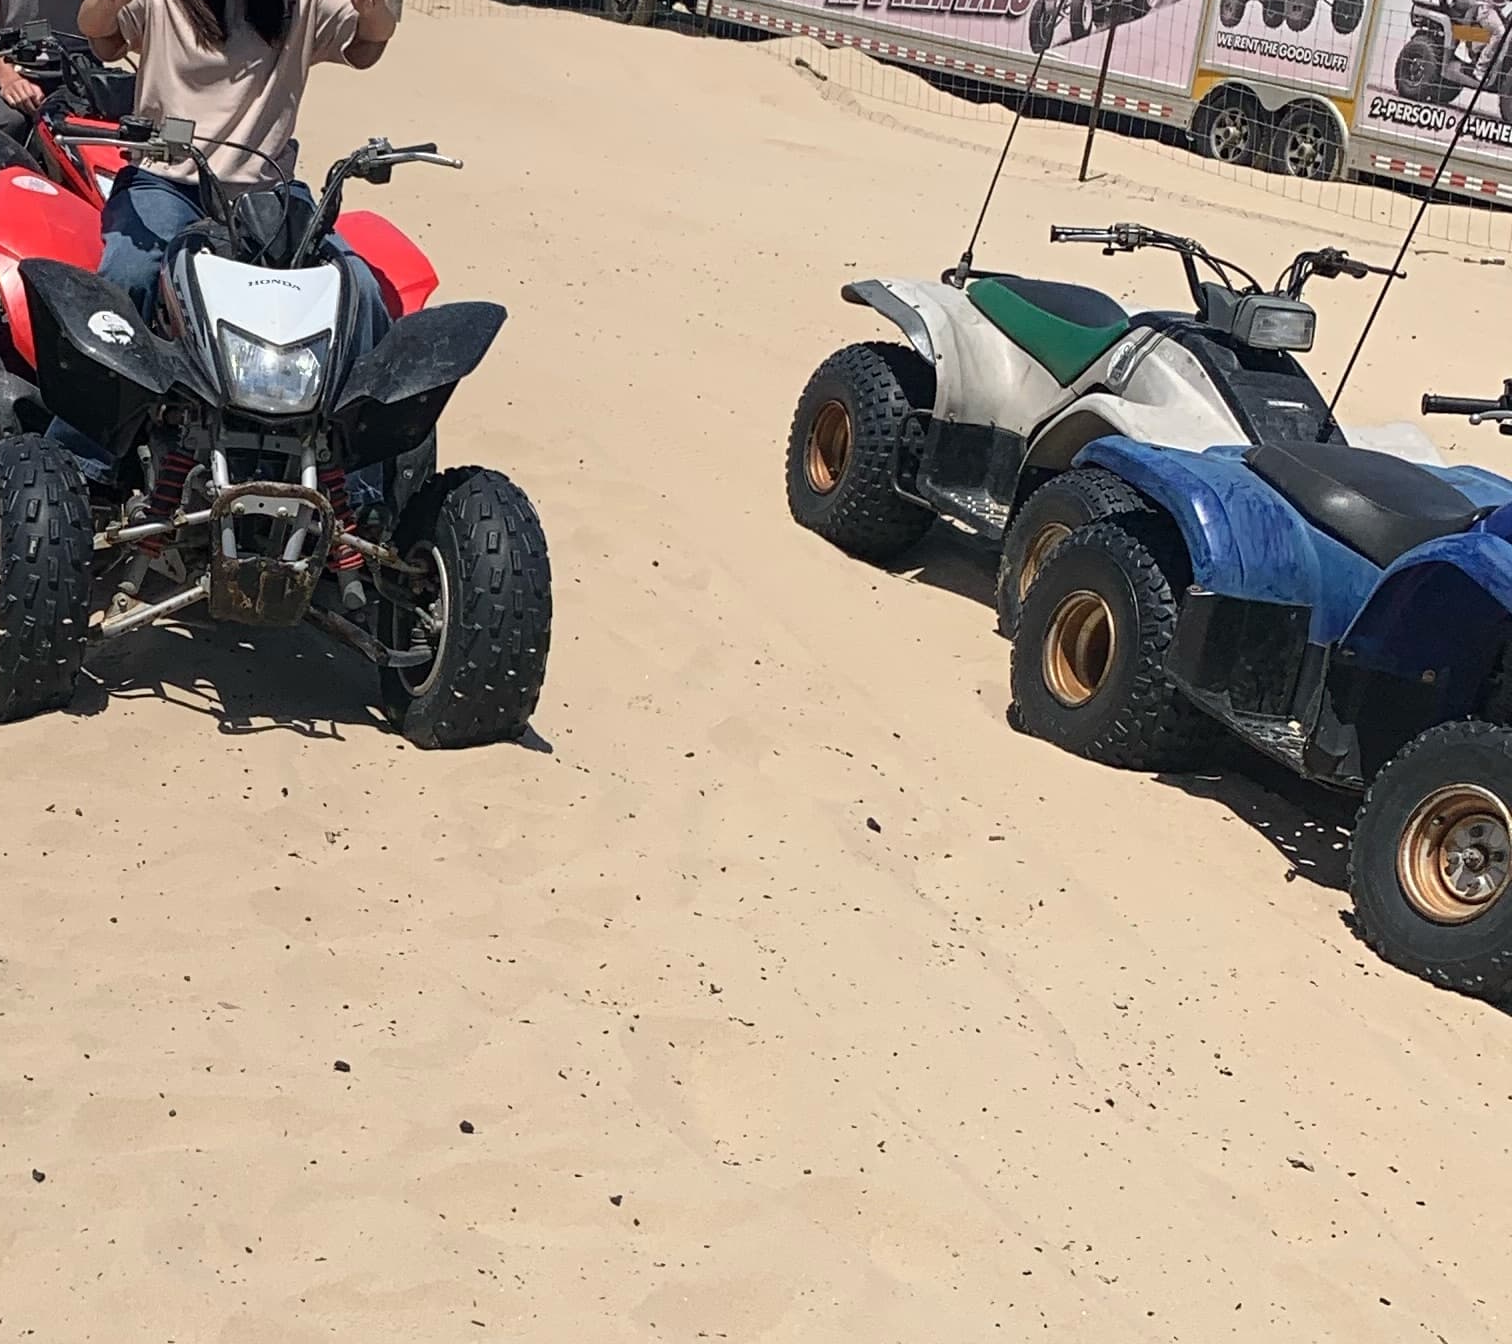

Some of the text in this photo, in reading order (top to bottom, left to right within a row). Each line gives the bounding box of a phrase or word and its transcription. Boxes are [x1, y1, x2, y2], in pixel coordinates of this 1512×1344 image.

[1217, 31, 1349, 72] WE RENT THE GOOD STUFF!
[1369, 97, 1445, 131] 2-PERSON
[248, 279, 301, 291] HONDA
